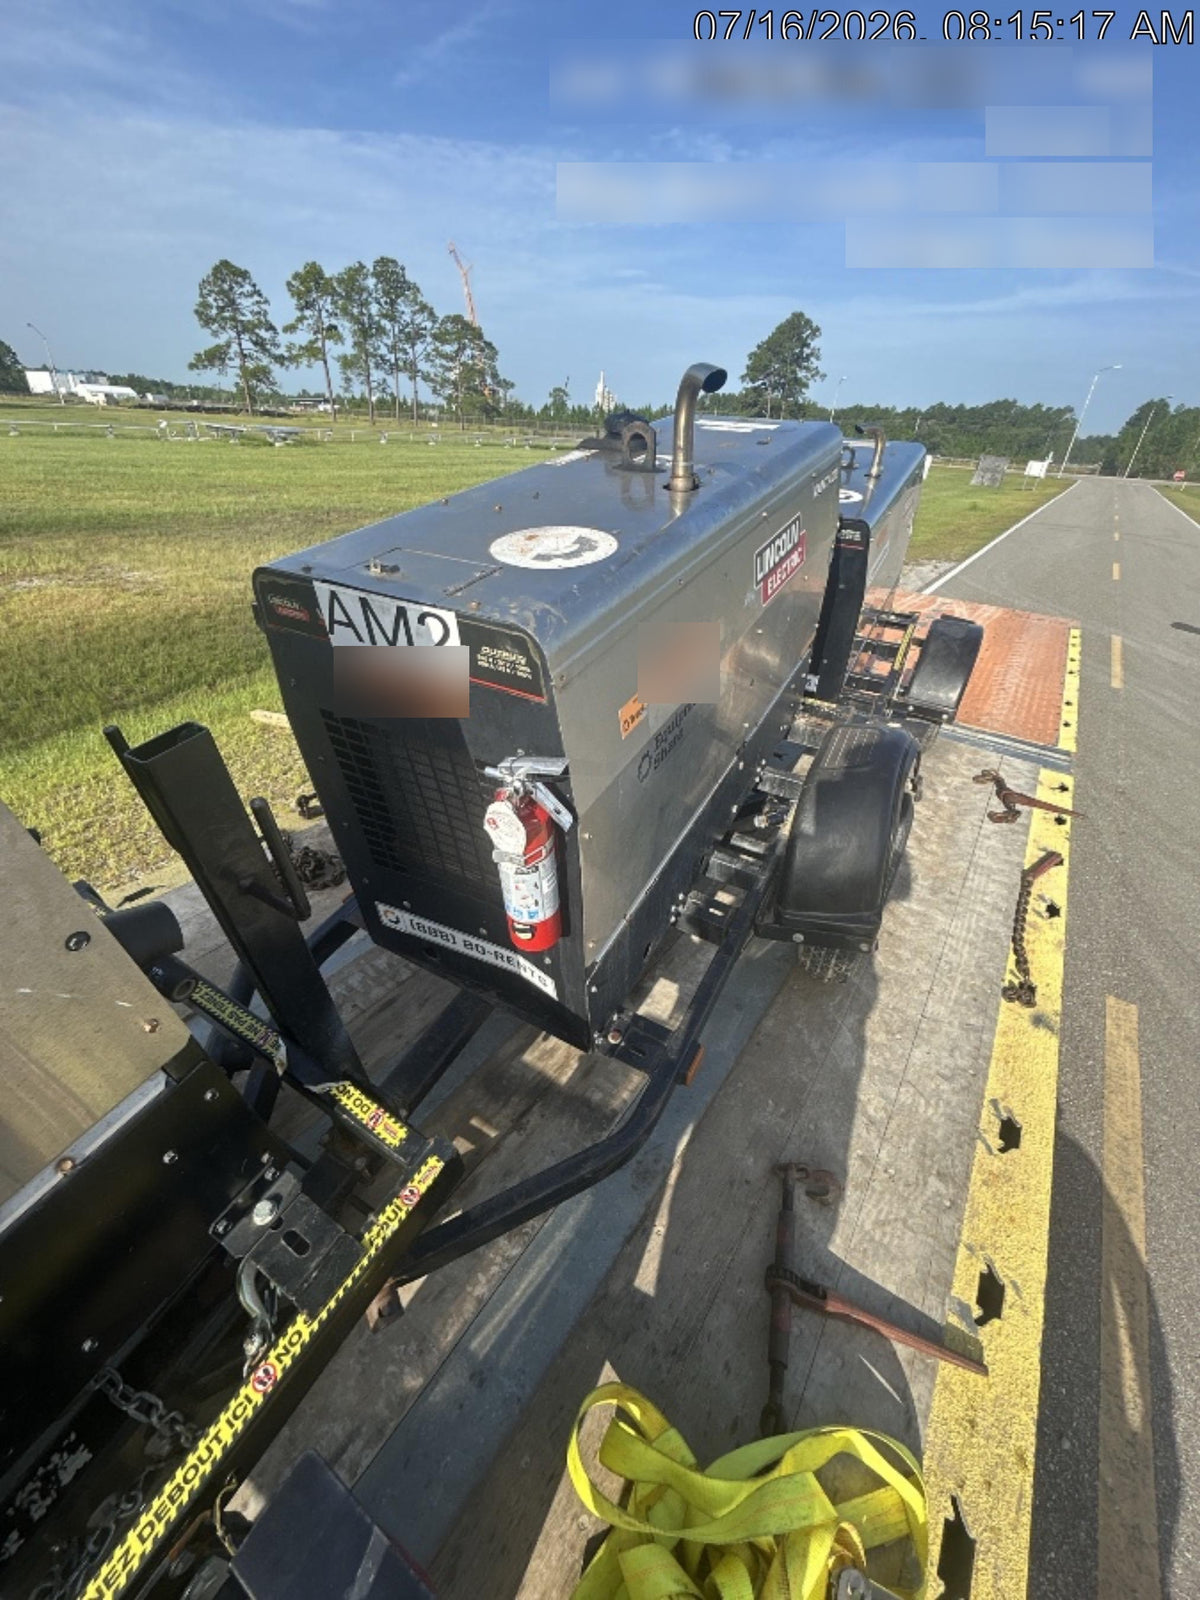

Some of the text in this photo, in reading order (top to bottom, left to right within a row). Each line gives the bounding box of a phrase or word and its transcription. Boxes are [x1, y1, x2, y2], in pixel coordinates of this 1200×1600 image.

[757, 520, 799, 582] LINCOLN
[767, 547, 803, 596] ELECTRIC
[410, 918, 549, 988] (888) 80-RENTS
[352, 1096, 371, 1115] DO
[274, 1329, 304, 1365] NO
[136, 1432, 226, 1545] DEBOUT
[226, 1393, 254, 1430] ICI
